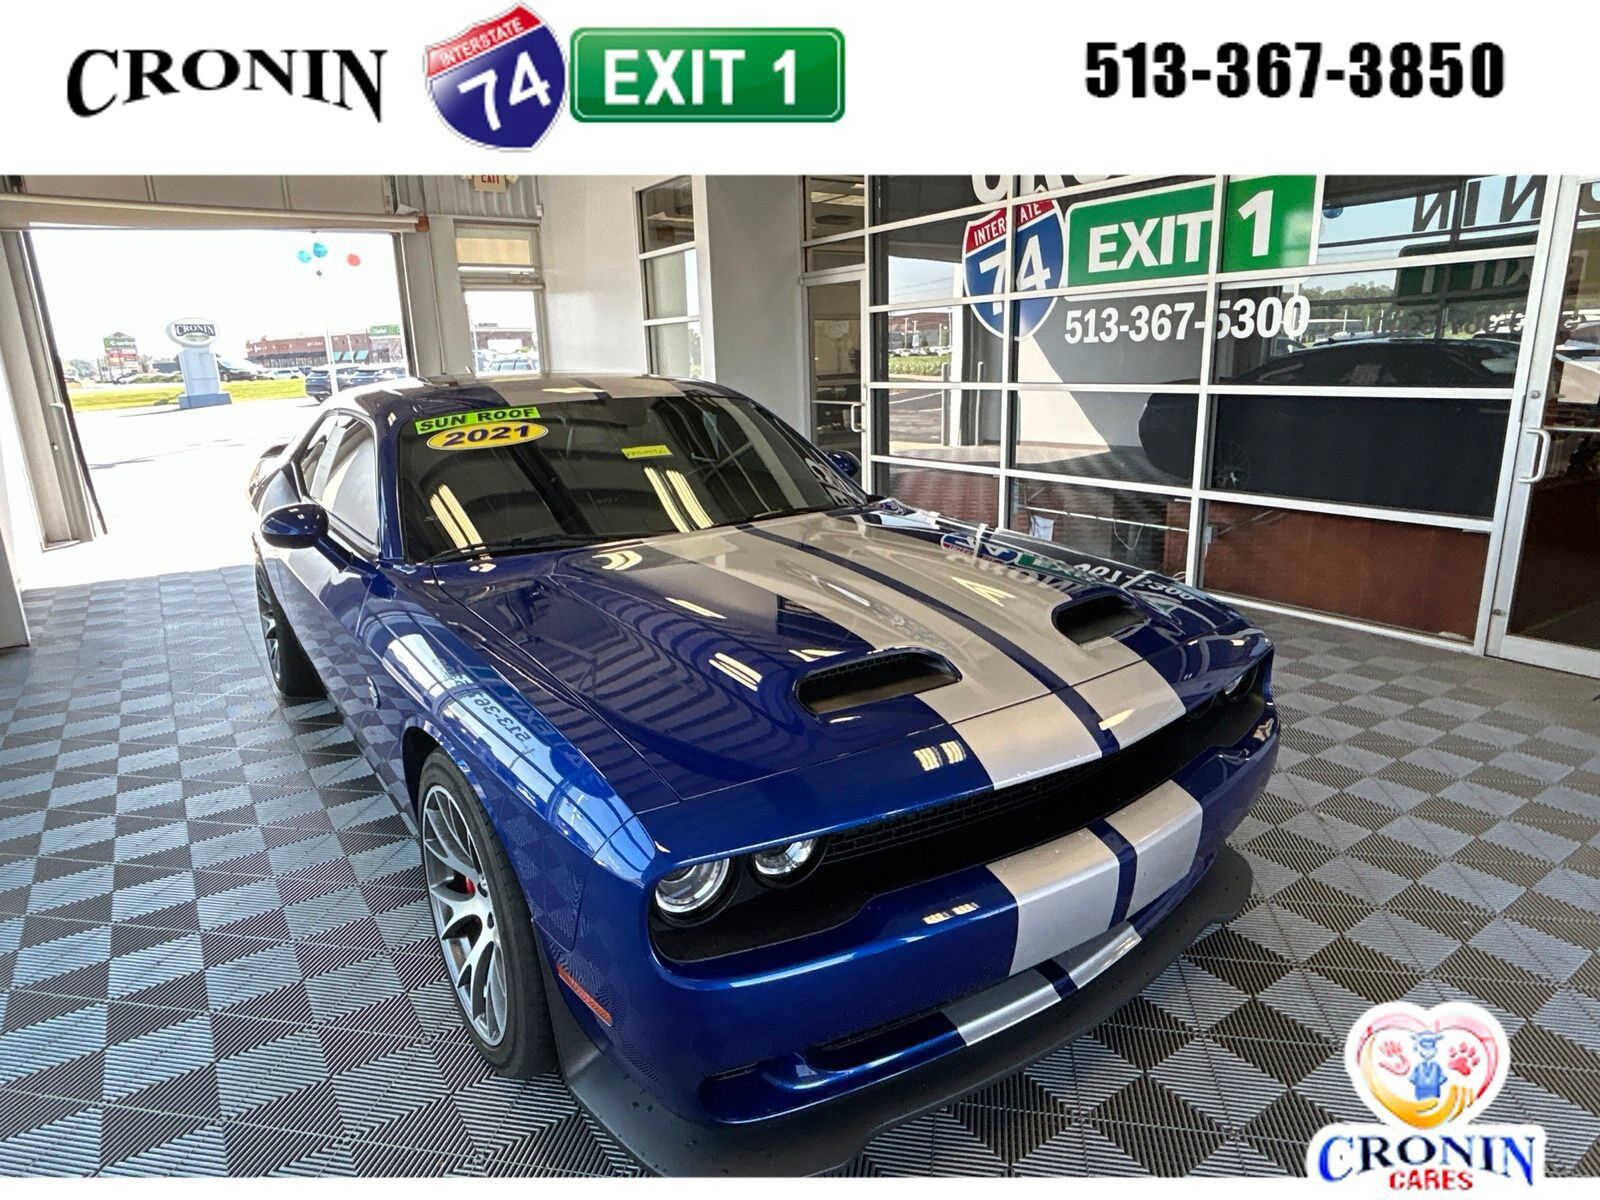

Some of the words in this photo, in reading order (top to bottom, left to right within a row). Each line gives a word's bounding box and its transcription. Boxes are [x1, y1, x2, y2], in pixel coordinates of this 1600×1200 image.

[973, 202, 1043, 247] INTERATE
[1088, 209, 1214, 274] EXIT
[1237, 189, 1275, 257] 1
[979, 233, 1052, 316] 74
[176, 325, 215, 336] CRONIN
[1064, 295, 1311, 345] 513-367-5300
[420, 415, 466, 432] SUN
[477, 408, 535, 422] ROOF
[442, 425, 530, 448] 2021
